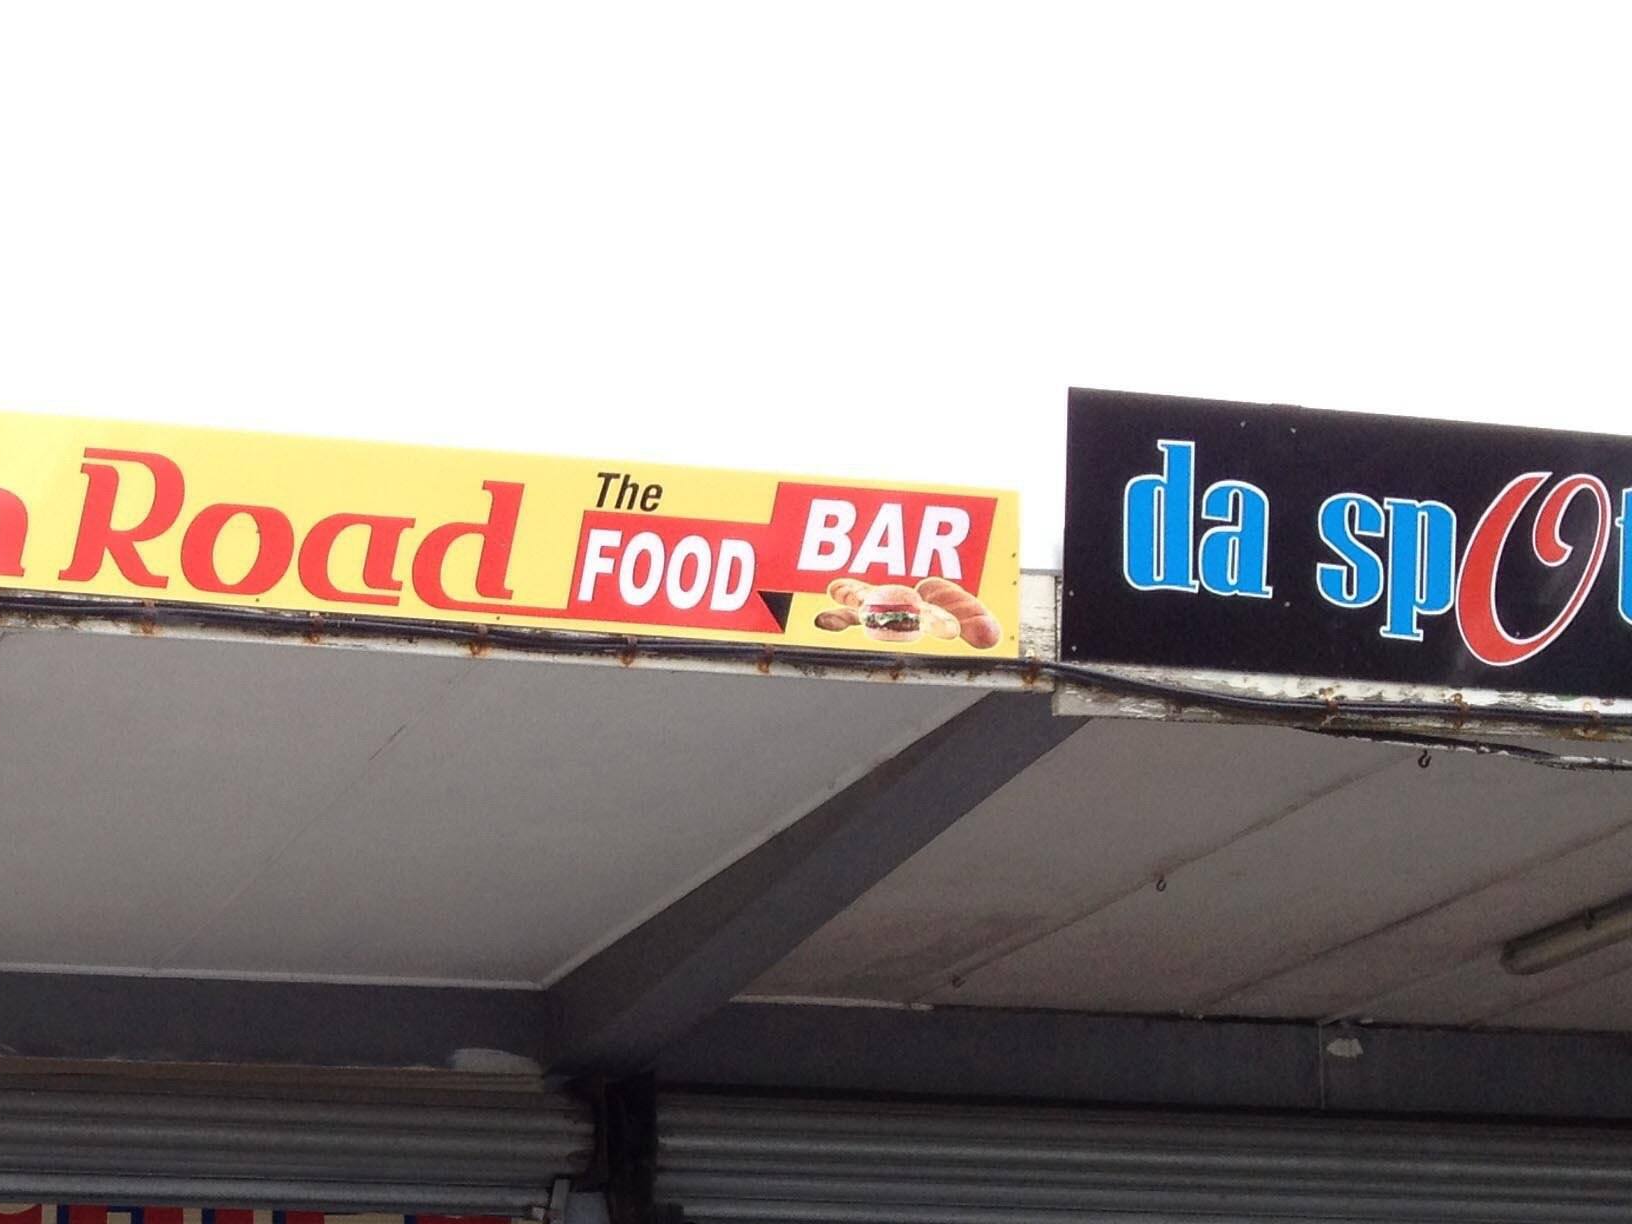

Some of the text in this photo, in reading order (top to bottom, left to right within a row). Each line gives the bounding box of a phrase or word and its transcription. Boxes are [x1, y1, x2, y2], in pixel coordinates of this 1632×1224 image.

[58, 447, 567, 618] Road
[593, 471, 664, 513] The
[1123, 439, 1273, 599] da
[577, 528, 758, 612] FOOD
[798, 497, 969, 579] BAR
